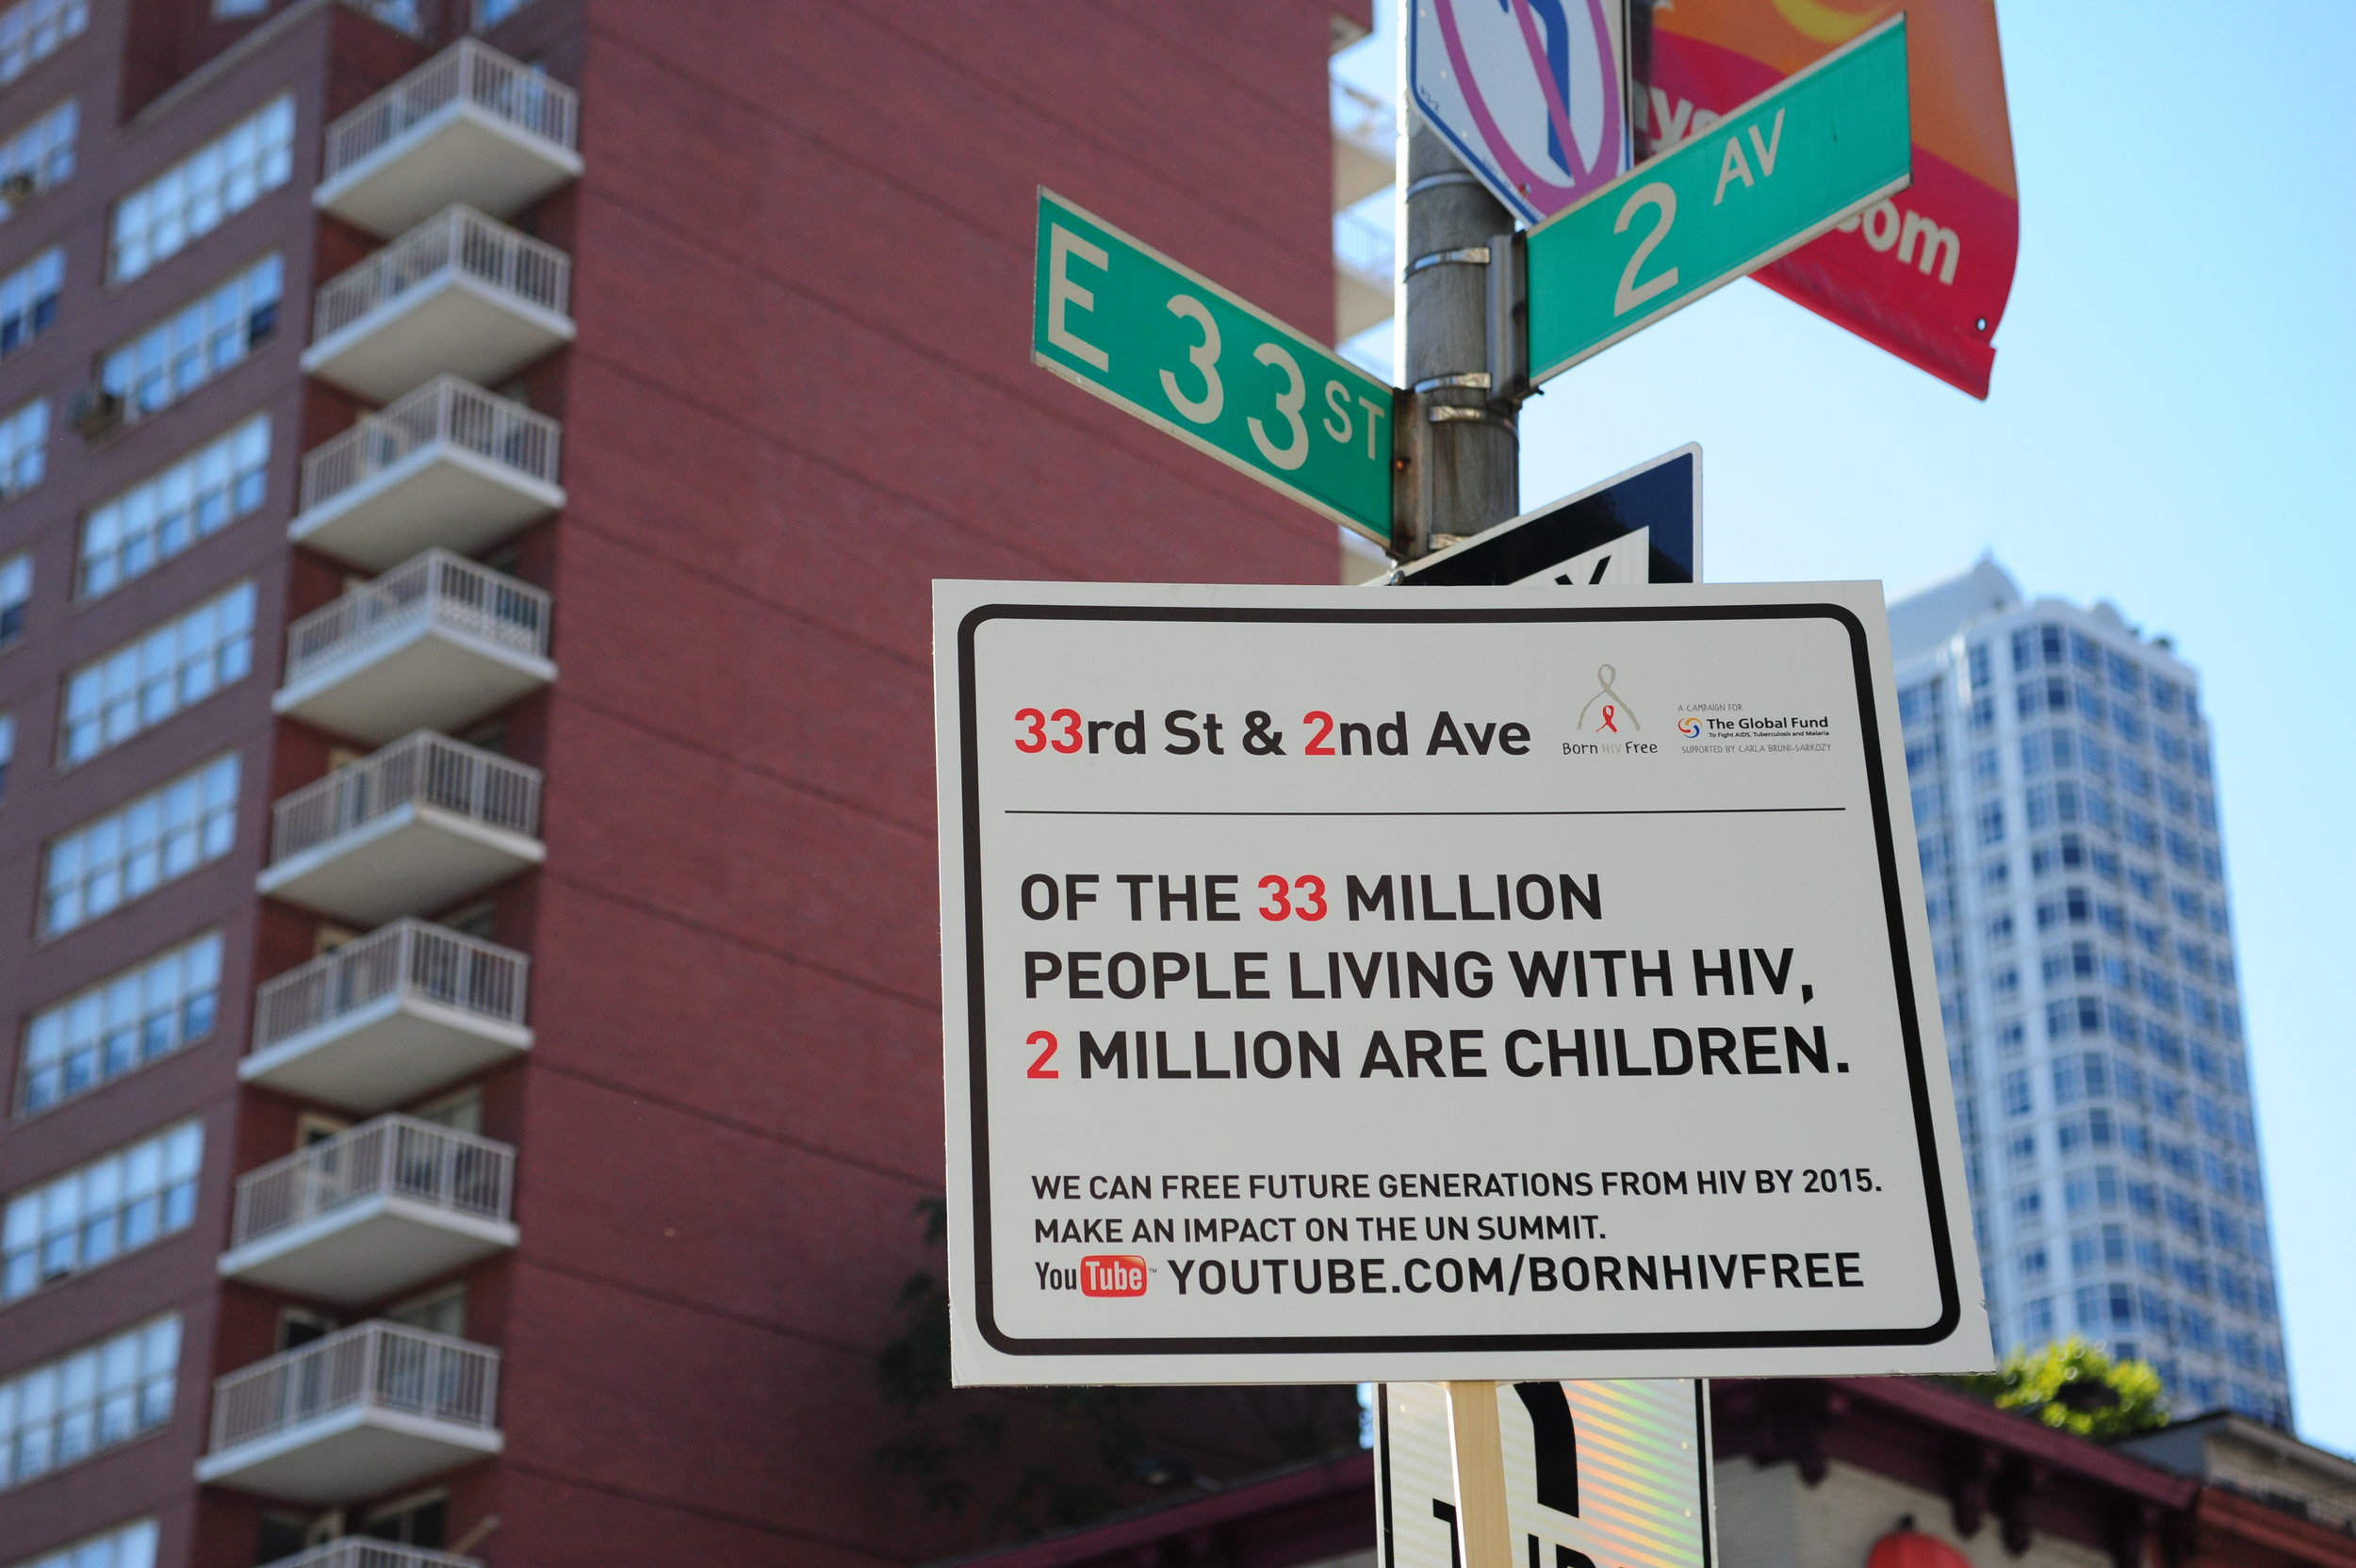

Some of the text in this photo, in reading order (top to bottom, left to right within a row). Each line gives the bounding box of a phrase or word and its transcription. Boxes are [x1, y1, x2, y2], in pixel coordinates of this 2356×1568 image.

[1613, 181, 1679, 317] 2
[1712, 106, 1787, 207] AV
[1047, 221, 1386, 471] E 33 ST
[1686, 703, 1726, 712] CAMPAIGN
[1727, 703, 1743, 711] FOR
[1706, 716, 1829, 730] The Global Fund
[1014, 707, 1531, 757] 33rd St & 2nd Ave
[1562, 741, 1659, 756] Born HIV Free
[1681, 743, 1832, 754] SUPPORTED BY CARLA BRUNI-SARKOZY
[1021, 873, 1603, 923] OF THE 33 MILLION
[1023, 947, 1814, 1005] PEOPLE LIVING WITH HIV,
[1025, 1025, 1850, 1080] 2 MILLION ARE CHILDREN.
[1031, 1168, 1883, 1200] WE CAN FREE FUTURE GENERATIONS FROM HIV BY 2015.
[1034, 1215, 1607, 1244] MAKE AN IMPACT ON THE UN SUMMIT.
[1167, 1251, 1865, 1297] YOUTUBE.COM/BORNHIVFREE
